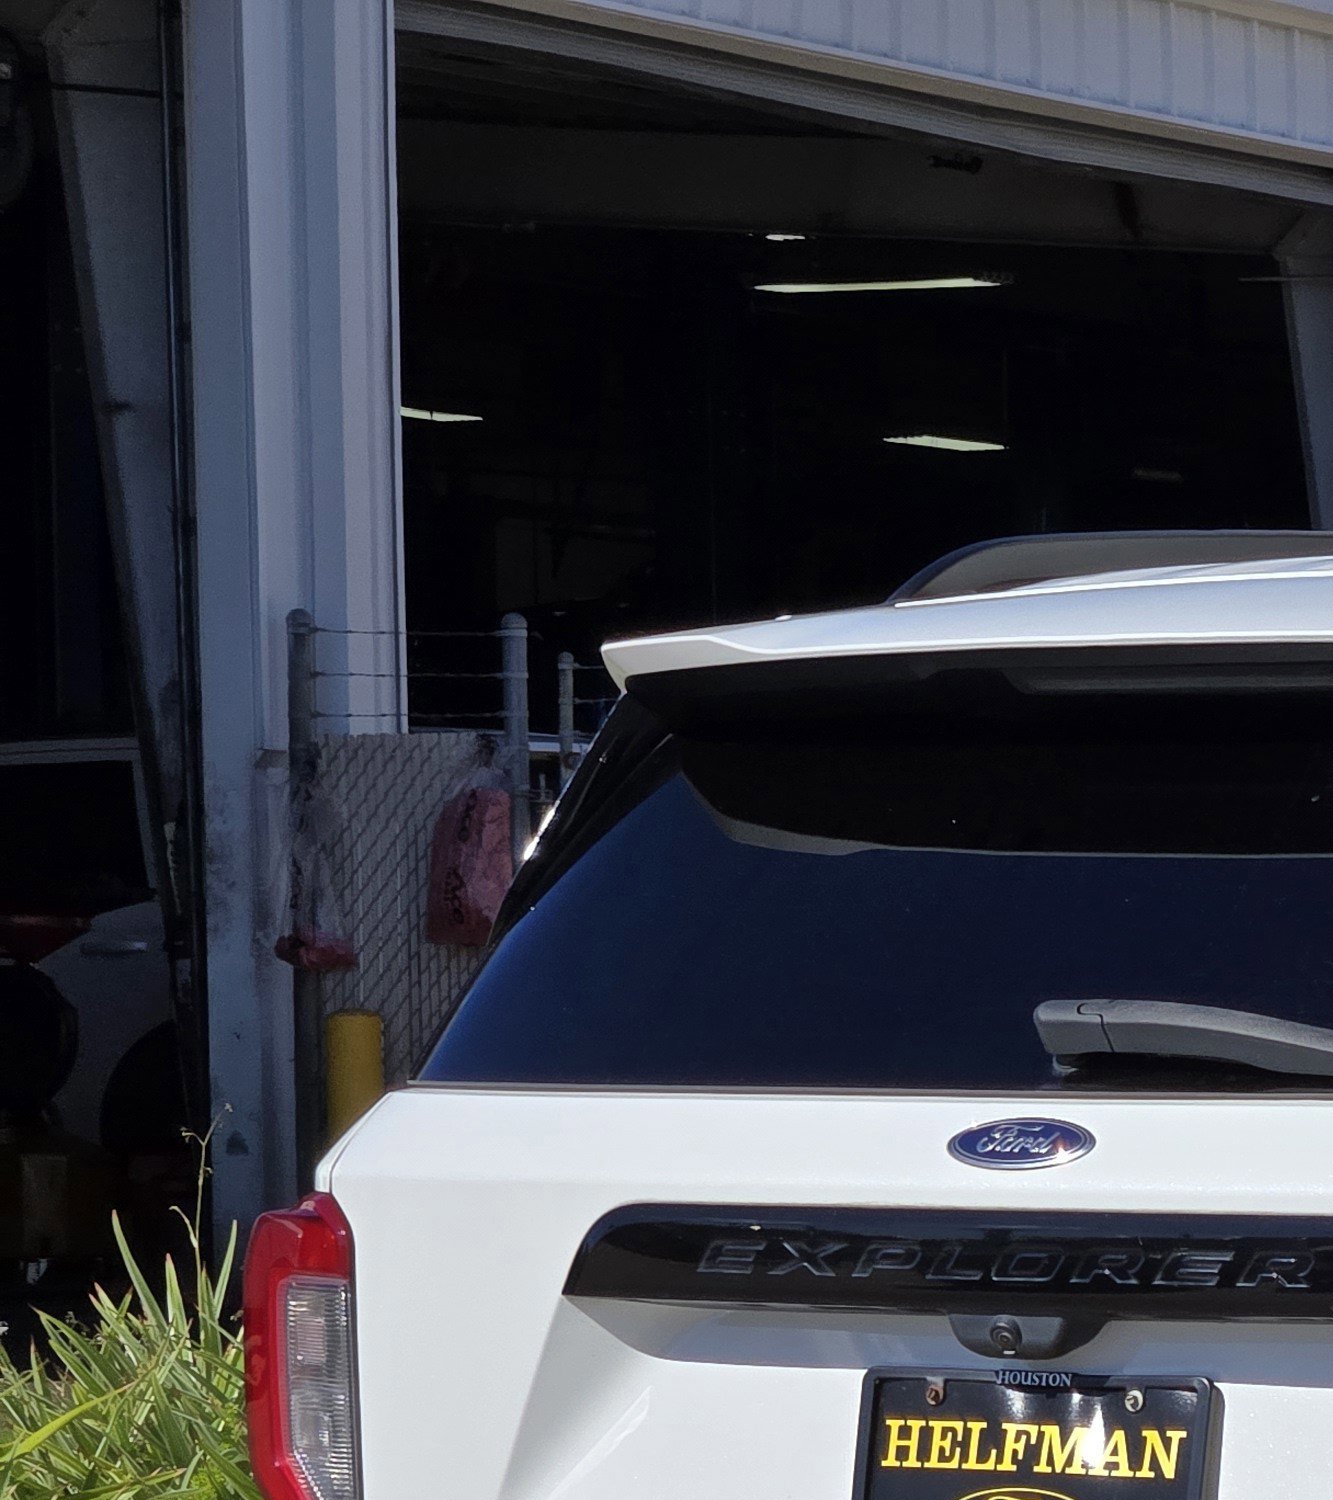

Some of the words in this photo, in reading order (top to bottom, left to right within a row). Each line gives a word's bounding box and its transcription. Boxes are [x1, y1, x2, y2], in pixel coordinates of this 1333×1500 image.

[976, 1124, 1060, 1154] Ford
[697, 1238, 1319, 1290] EXPLORER
[999, 1370, 1073, 1388] HOUSTON
[881, 1419, 1187, 1479] HELFMAN
